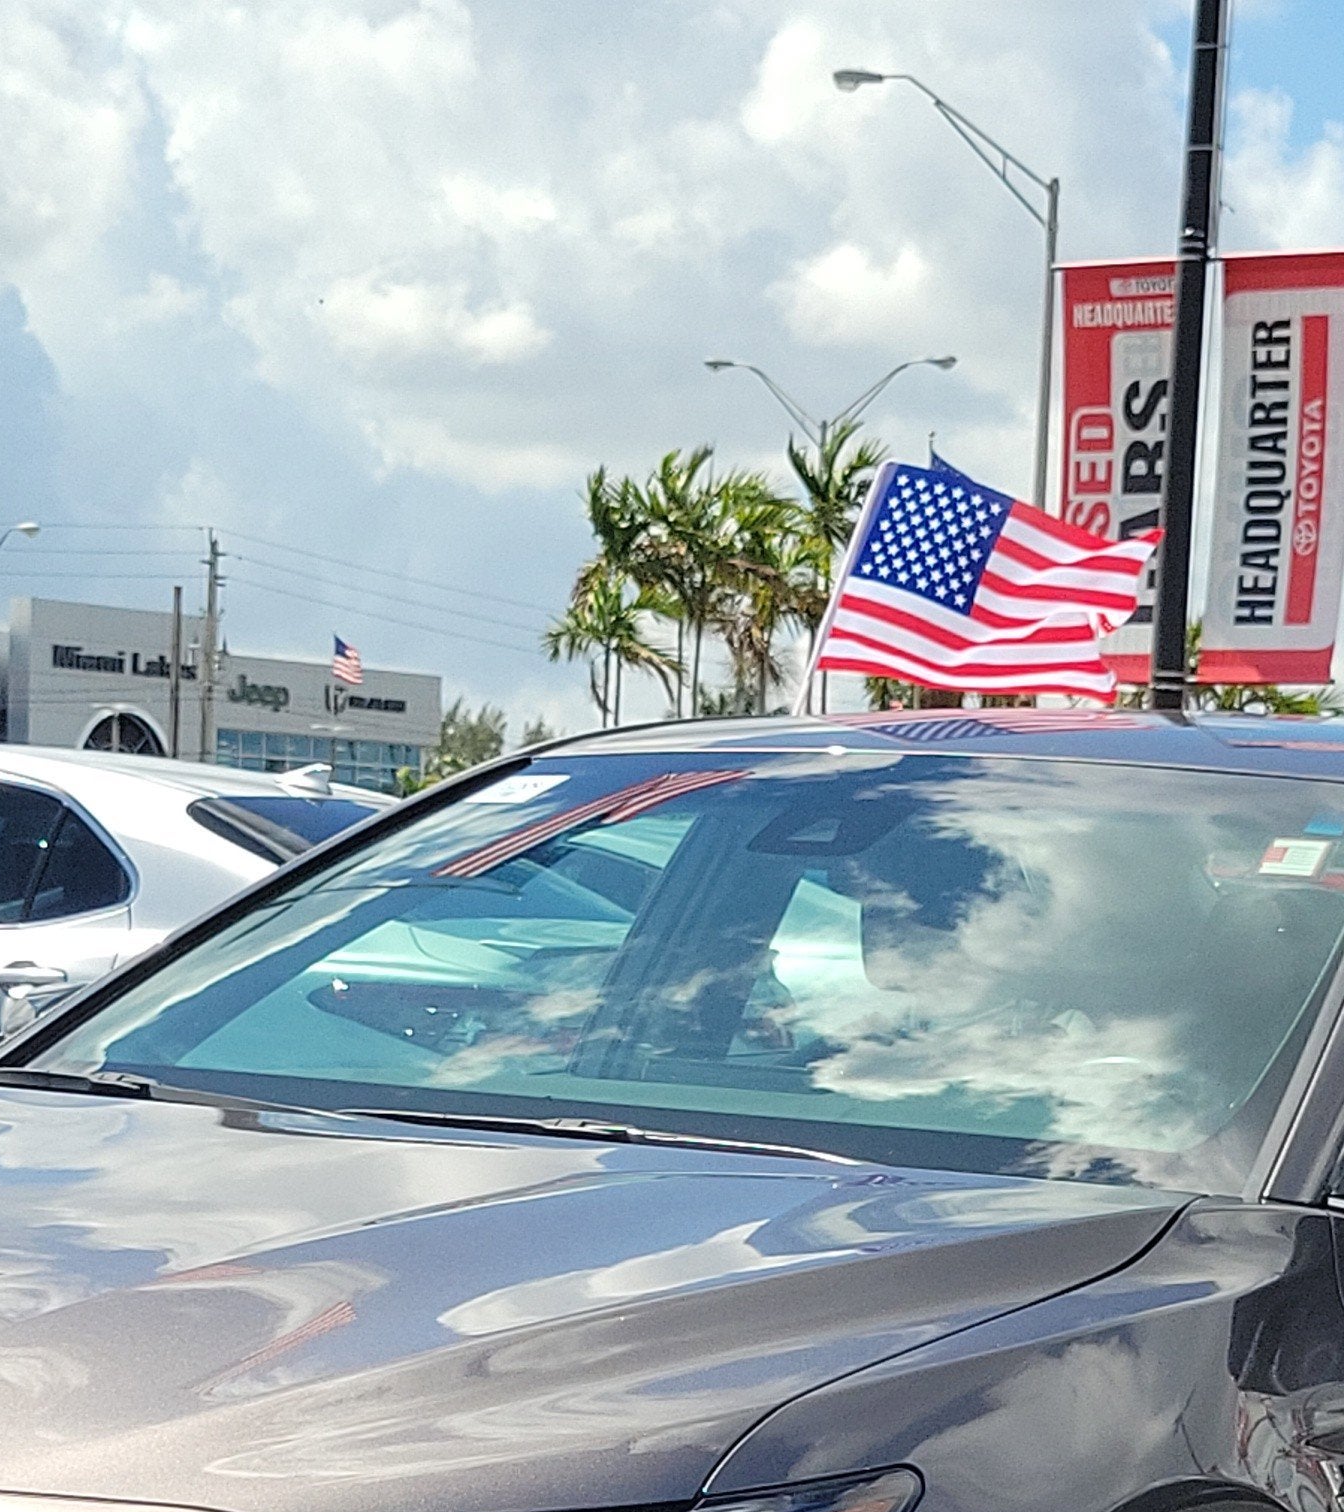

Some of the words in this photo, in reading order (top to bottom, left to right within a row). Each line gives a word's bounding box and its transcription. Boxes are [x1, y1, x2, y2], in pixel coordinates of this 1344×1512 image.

[1136, 279, 1173, 292] TOYOT
[1073, 301, 1175, 328] HEADQUARTE
[1070, 411, 1115, 540] SED
[1234, 317, 1292, 626] HEADQUARTER
[1297, 399, 1323, 517] TOYOTA
[53, 645, 125, 674] Miami
[133, 653, 197, 680] Laks
[228, 674, 290, 712] Jeep
